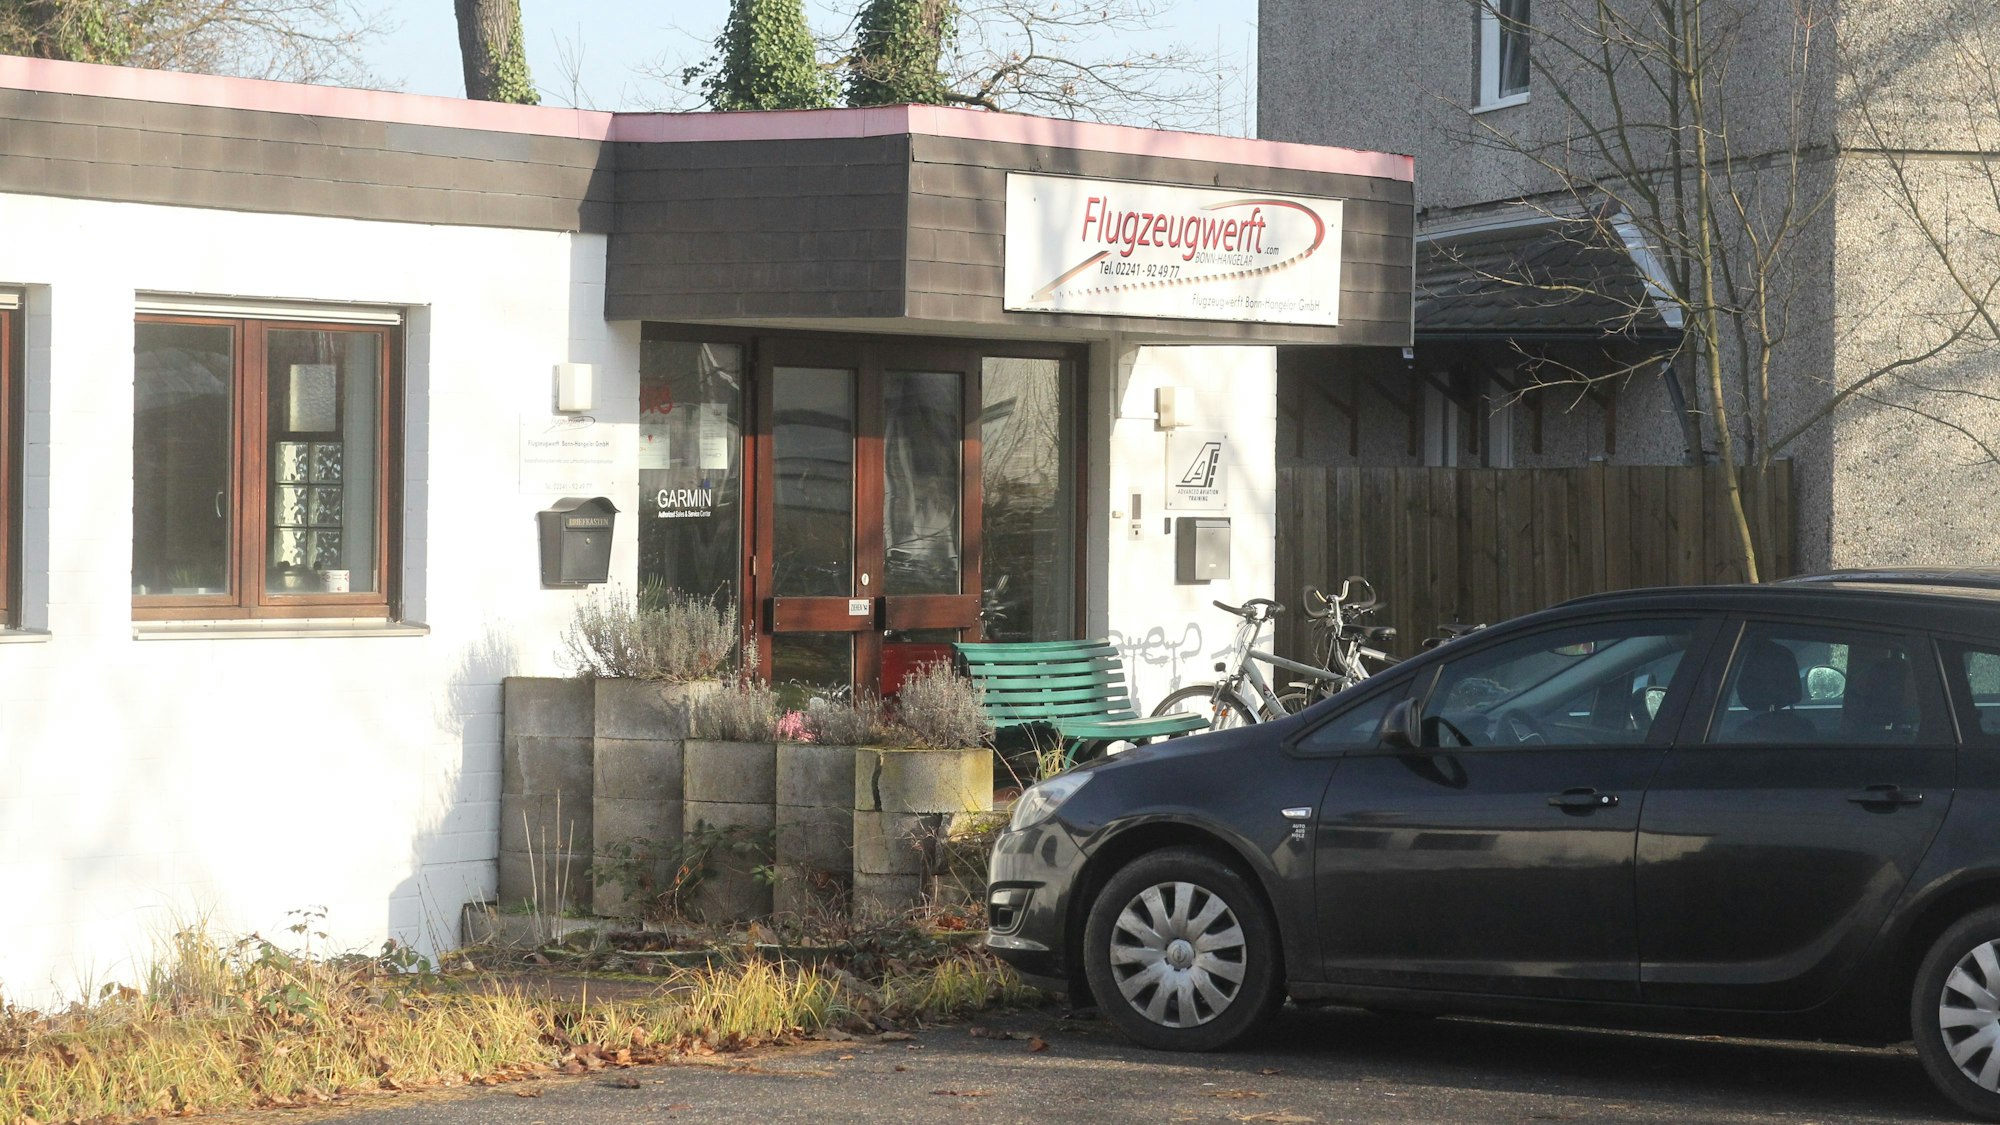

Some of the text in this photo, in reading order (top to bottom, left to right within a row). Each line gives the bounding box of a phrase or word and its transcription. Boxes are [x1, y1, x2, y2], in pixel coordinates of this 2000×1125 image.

[1081, 196, 1266, 261] Flugzeugwerft
[1195, 251, 1253, 267] BONN-HANGELAR
[1099, 261, 1114, 276] Tel.
[1115, 262, 1141, 277] 02241
[1146, 264, 1159, 277] 92
[1159, 264, 1169, 278] 49
[1169, 265, 1180, 279] 77
[1192, 293, 1321, 313] Flugzeugwerft Bonn-Hangelar GmbH
[657, 488, 712, 508] GARMIN
[568, 517, 609, 526] BRIEFKASTEN
[688, 510, 700, 518] Service
